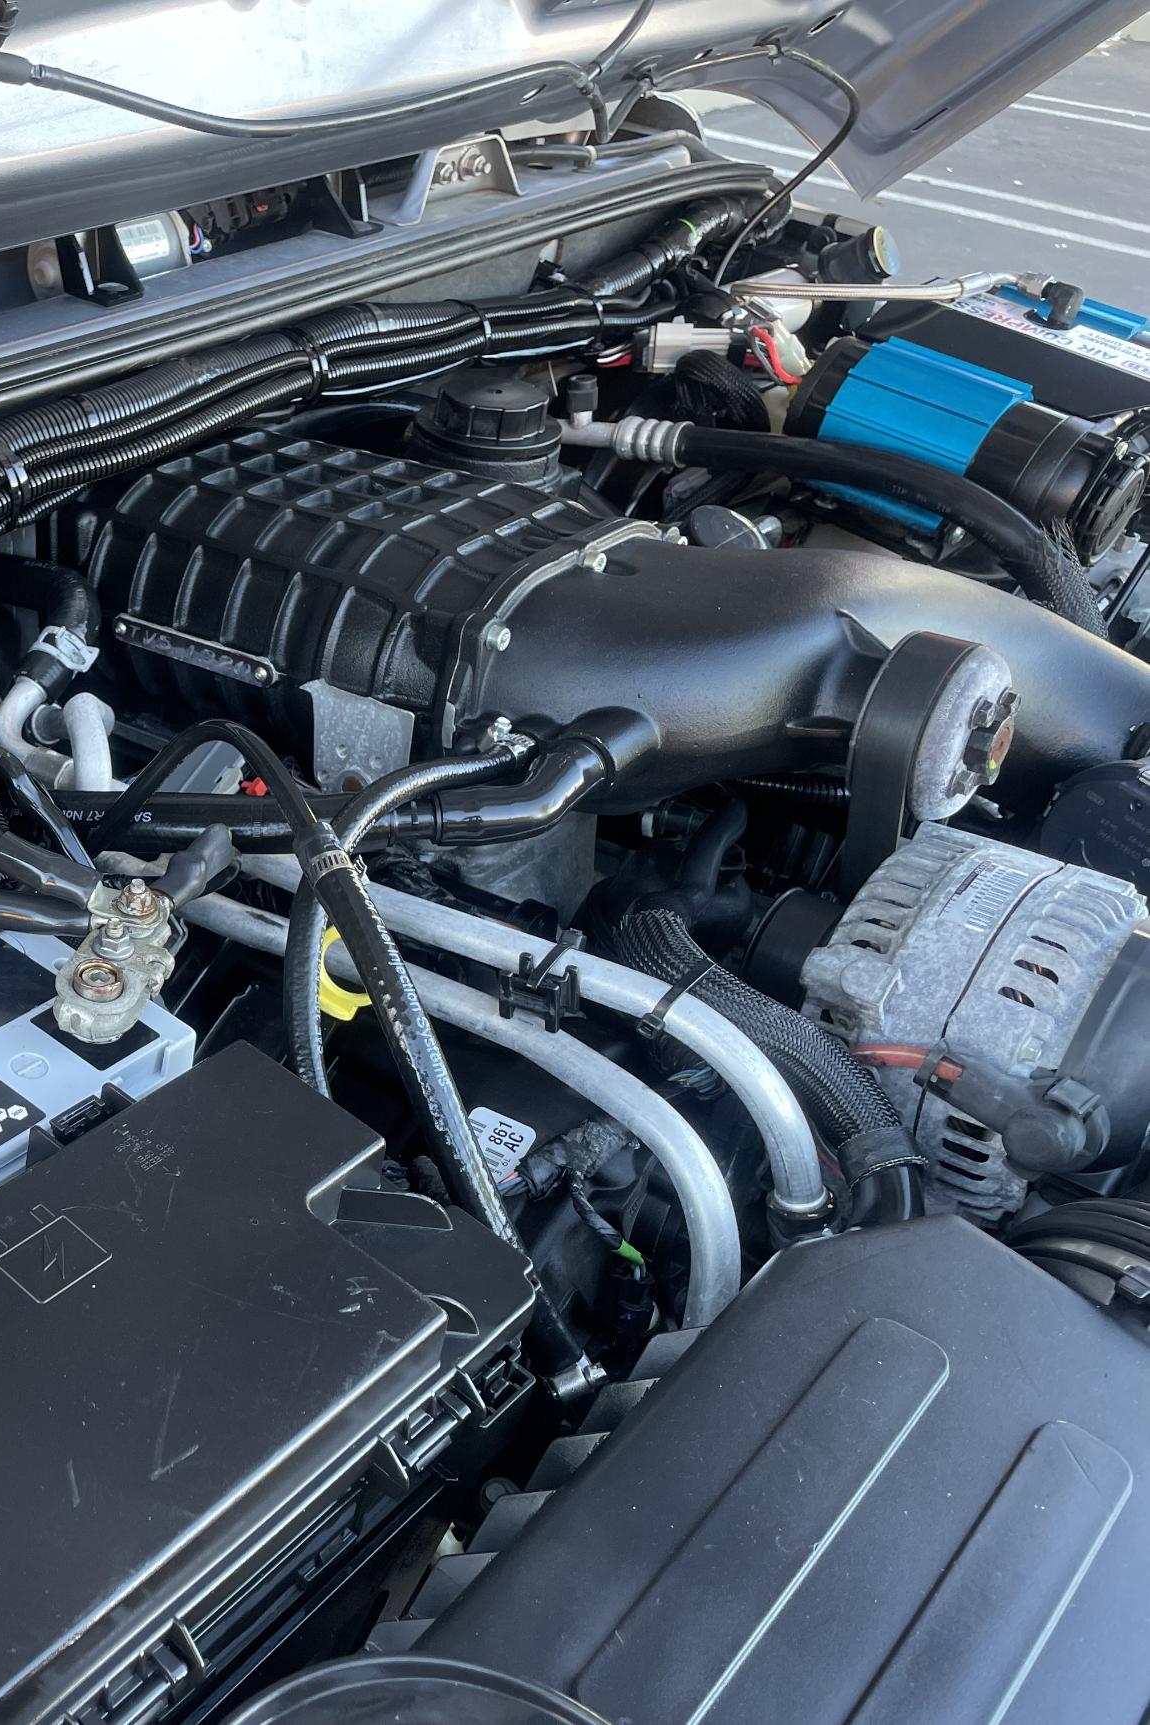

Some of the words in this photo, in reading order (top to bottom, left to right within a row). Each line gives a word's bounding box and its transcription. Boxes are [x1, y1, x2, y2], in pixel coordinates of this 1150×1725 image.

[953, 301, 1073, 345] COMPRESS
[387, 946, 422, 1013] Injection
[488, 1120, 513, 1146] 861
[503, 1132, 524, 1153] AC
